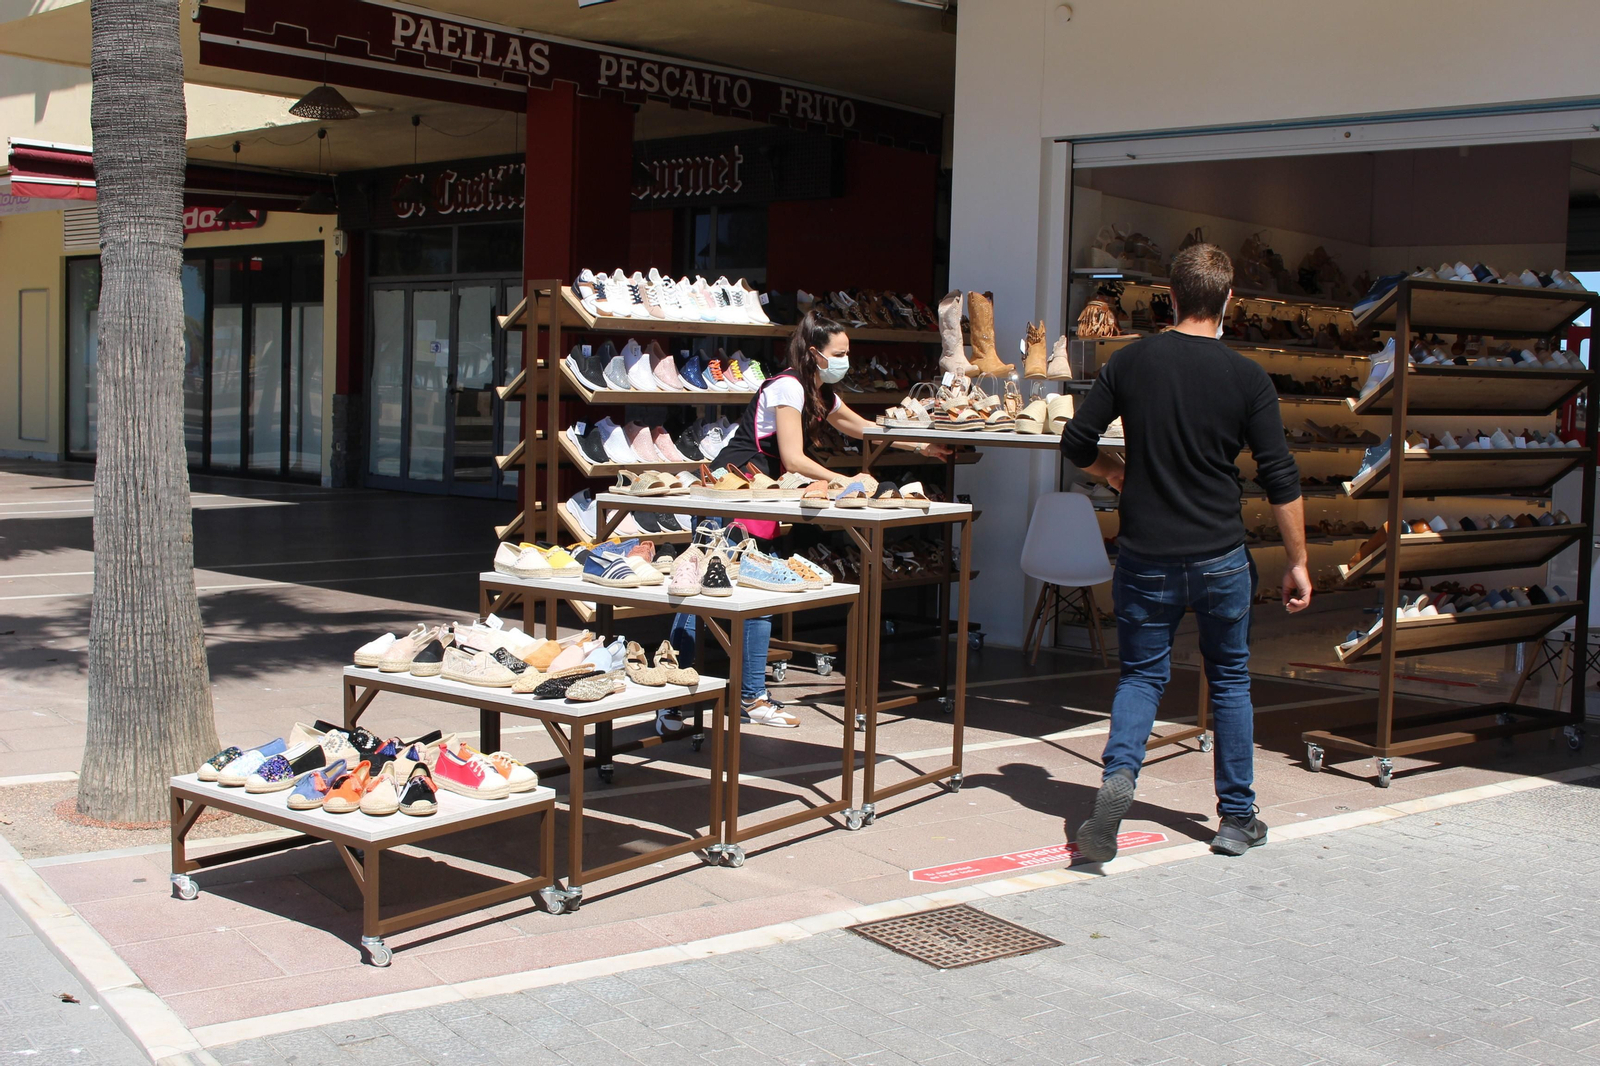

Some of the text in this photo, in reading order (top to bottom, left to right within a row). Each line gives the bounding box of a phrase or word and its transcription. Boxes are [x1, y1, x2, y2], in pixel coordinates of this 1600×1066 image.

[391, 12, 550, 76] PAELLAS
[598, 55, 751, 107] PESCAITO
[779, 86, 855, 127] FRITO
[631, 145, 744, 200] urmet
[1001, 845, 1072, 862] 1 metro
